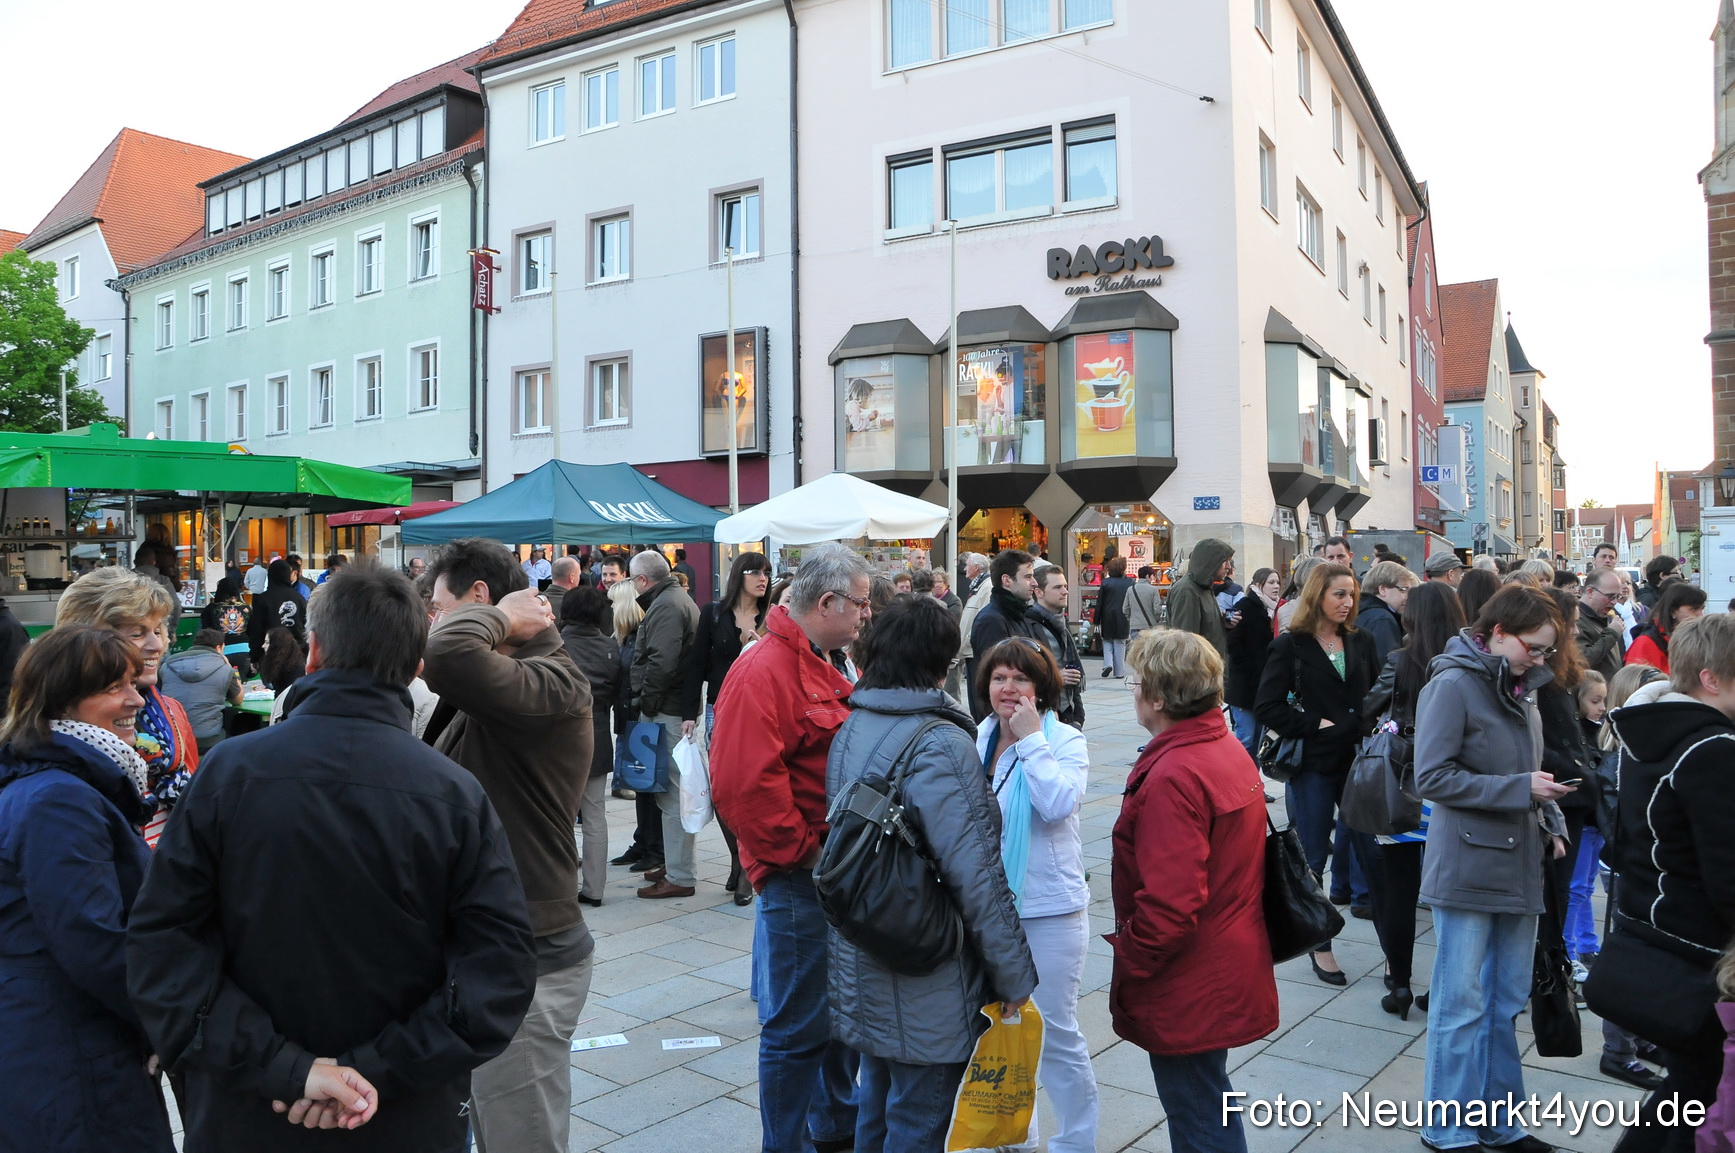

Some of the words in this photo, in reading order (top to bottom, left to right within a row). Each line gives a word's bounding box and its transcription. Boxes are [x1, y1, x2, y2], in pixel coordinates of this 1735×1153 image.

[1047, 235, 1174, 280] RACKL
[478, 261, 489, 306] Achatz
[1065, 285, 1090, 295] am
[1094, 275, 1162, 292] Rathaus
[976, 348, 1000, 359] Jahre
[960, 361, 992, 381] RACKL
[588, 500, 673, 522] RACKL
[1107, 522, 1133, 535] RACKL
